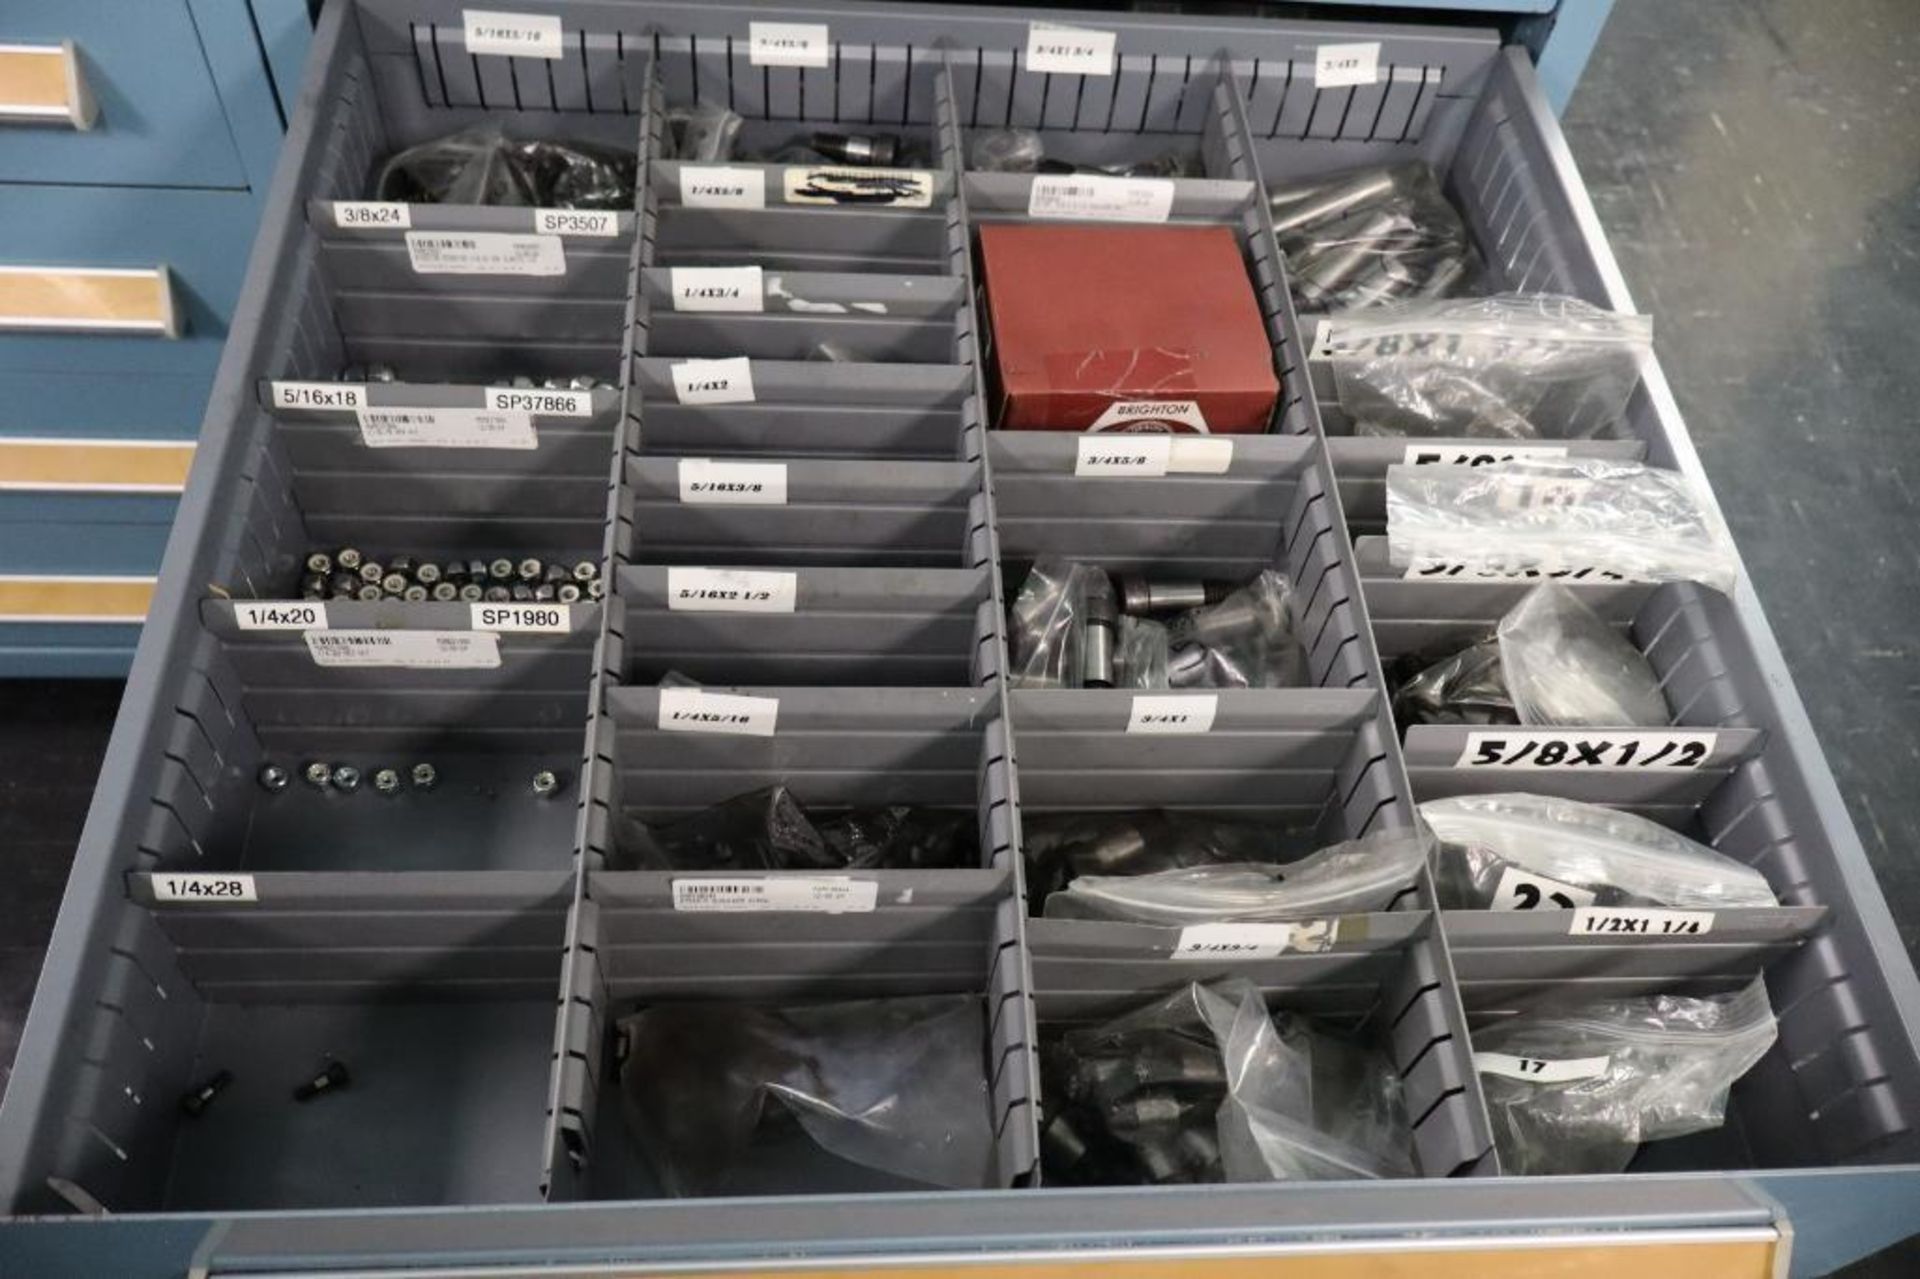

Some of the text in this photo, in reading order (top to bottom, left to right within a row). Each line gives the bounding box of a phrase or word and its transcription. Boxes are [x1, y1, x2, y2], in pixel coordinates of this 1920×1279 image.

[343, 206, 402, 223] 3/8x24
[543, 214, 610, 232] SP3507
[683, 286, 740, 299] 1/4X3/4
[686, 380, 730, 393] 1/4X2
[283, 387, 359, 406] 5/16x18
[496, 394, 578, 413] SP37866
[1117, 404, 1190, 416] BRIGHTON
[1087, 455, 1147, 466] 3/4X5/8
[678, 588, 771, 601] 5/16X2 1/2
[248, 608, 317, 626] 1/4x20
[481, 609, 560, 626] SP1980
[1140, 715, 1189, 728] 3/4X1
[1471, 740, 1708, 767] 5/8X1/2
[166, 880, 244, 898] 1/4x28
[1584, 915, 1651, 933] 1/2X1
[1518, 1058, 1548, 1074] 17
